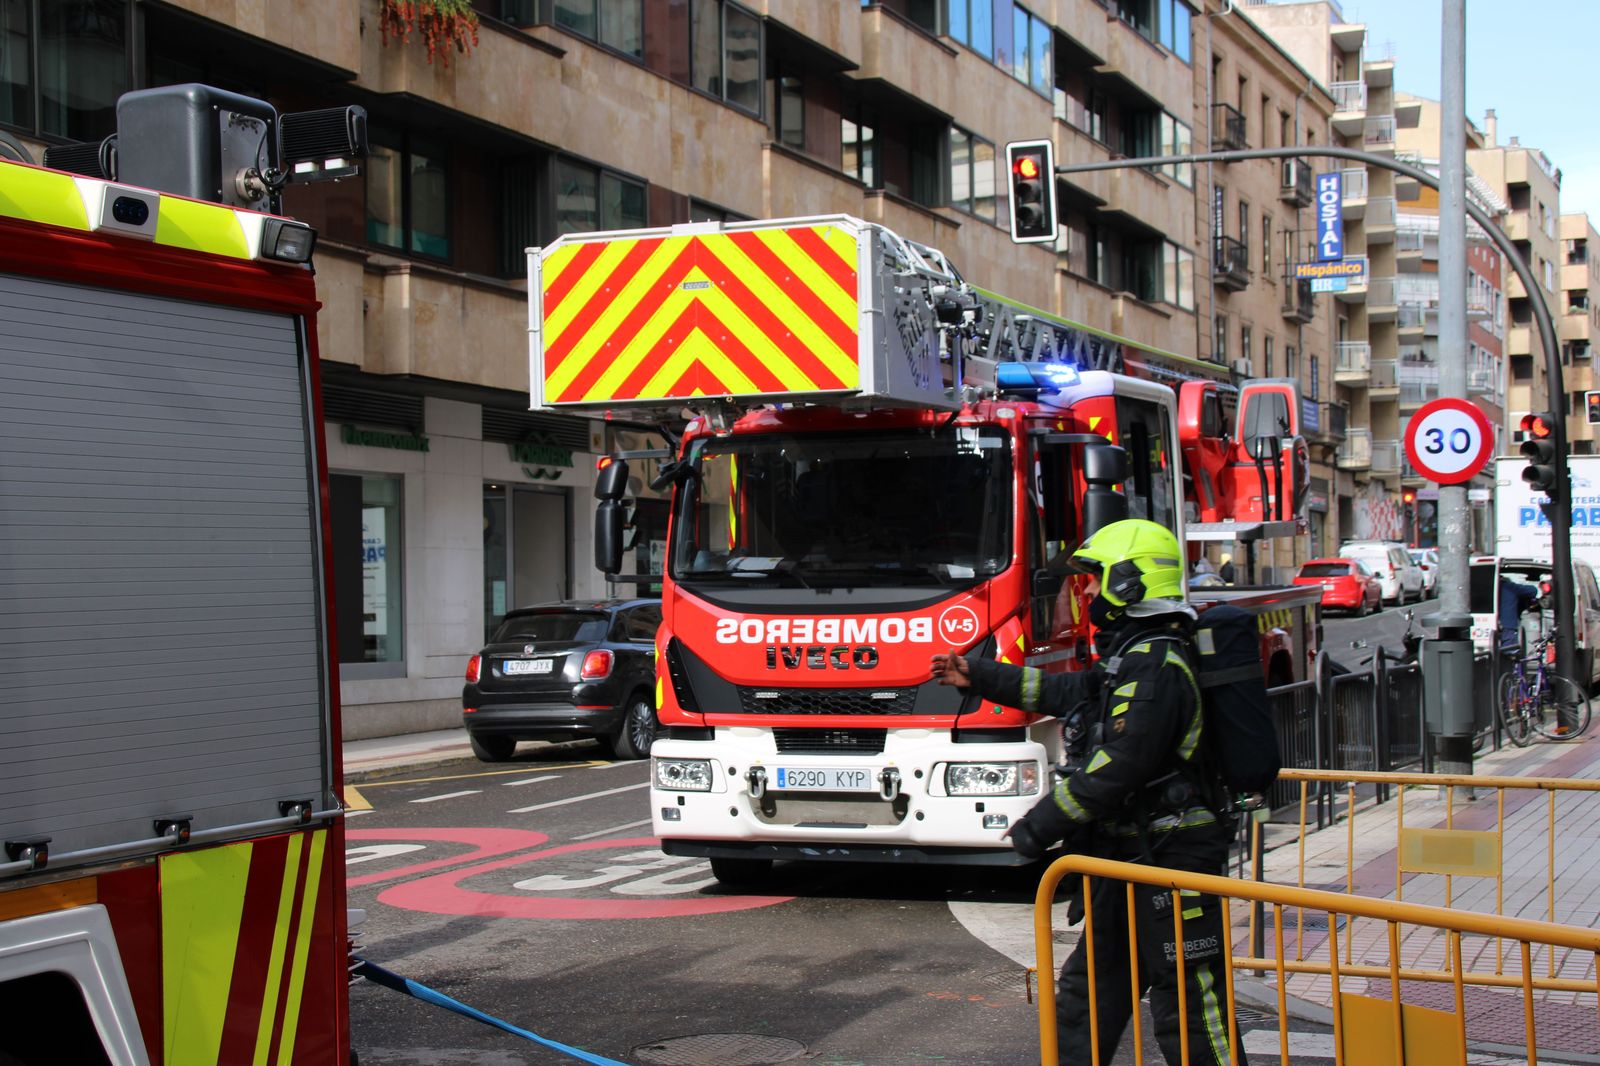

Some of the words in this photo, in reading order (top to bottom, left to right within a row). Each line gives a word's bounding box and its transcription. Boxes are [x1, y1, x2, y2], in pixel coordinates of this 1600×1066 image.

[1320, 177, 1339, 257] HOSTAL
[1296, 263, 1362, 277] Hispánico
[1425, 428, 1471, 454] 30
[943, 618, 974, 633] V-5
[766, 645, 879, 670] IVECO
[788, 771, 826, 787] 6290
[836, 771, 865, 787] KYP
